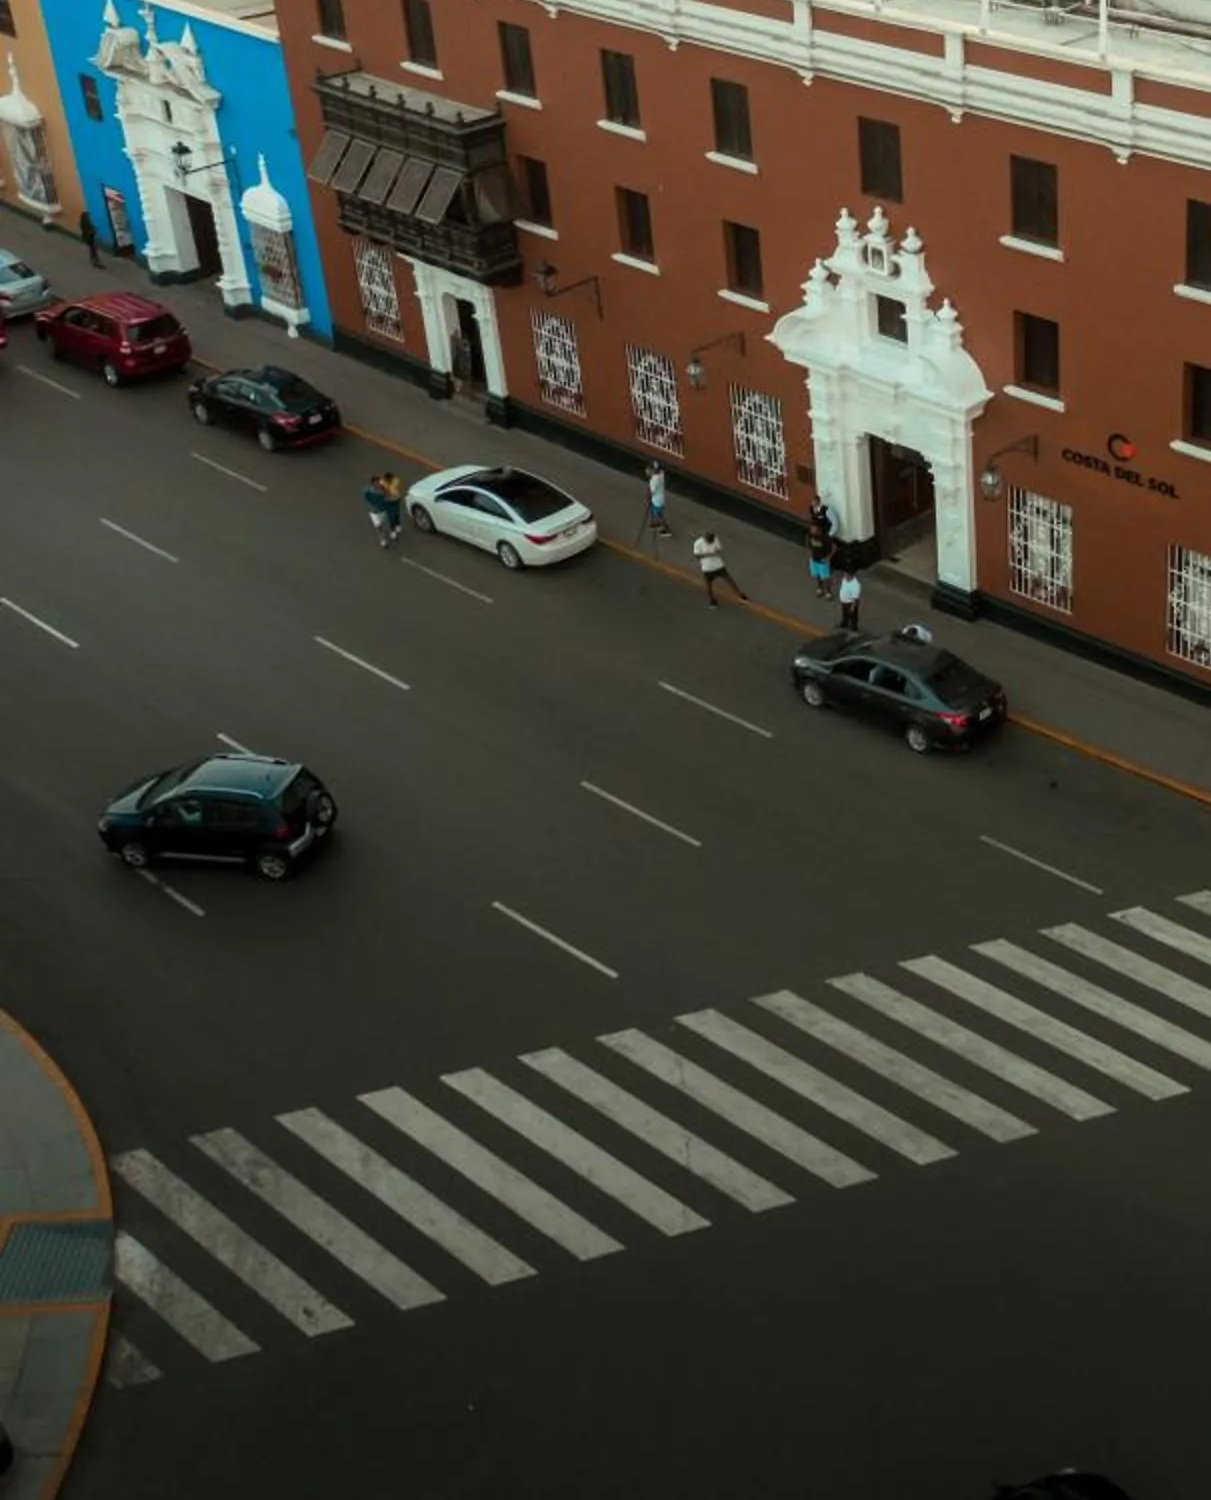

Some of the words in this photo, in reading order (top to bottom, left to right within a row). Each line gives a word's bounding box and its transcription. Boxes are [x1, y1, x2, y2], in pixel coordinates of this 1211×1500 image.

[1062, 449, 1110, 476] COSTA
[1114, 466, 1143, 488] DEL
[1148, 477, 1180, 499] SOL
